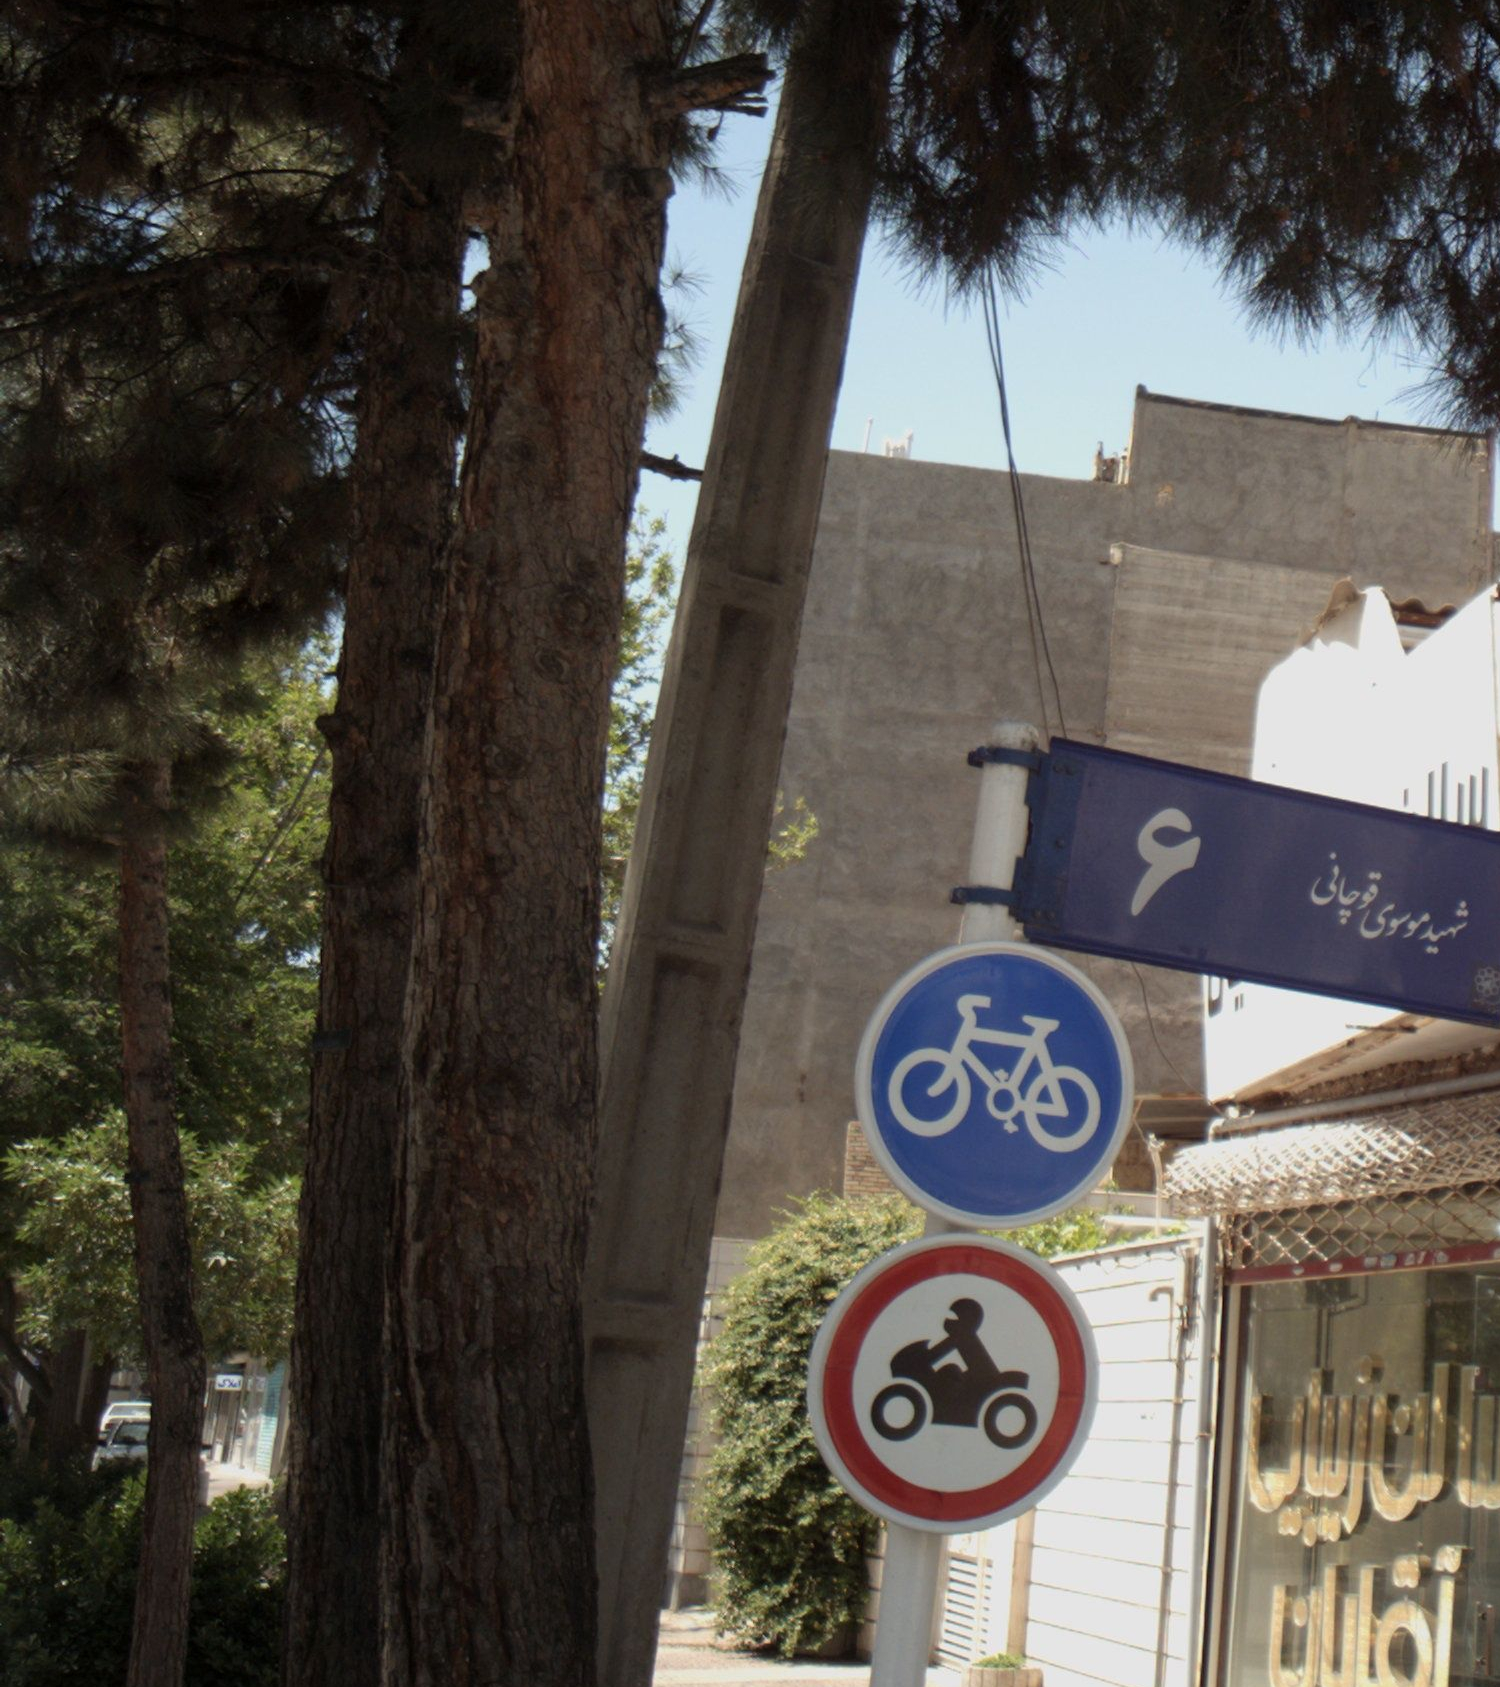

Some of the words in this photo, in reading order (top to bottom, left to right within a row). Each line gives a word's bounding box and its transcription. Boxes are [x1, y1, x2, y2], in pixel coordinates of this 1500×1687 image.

[1131, 807, 1200, 916] ۶
[1310, 852, 1383, 925] قوچانی
[1360, 903, 1431, 939] موسوی
[1419, 900, 1470, 954] شهید
[1248, 1355, 1375, 1547] زیبایی
